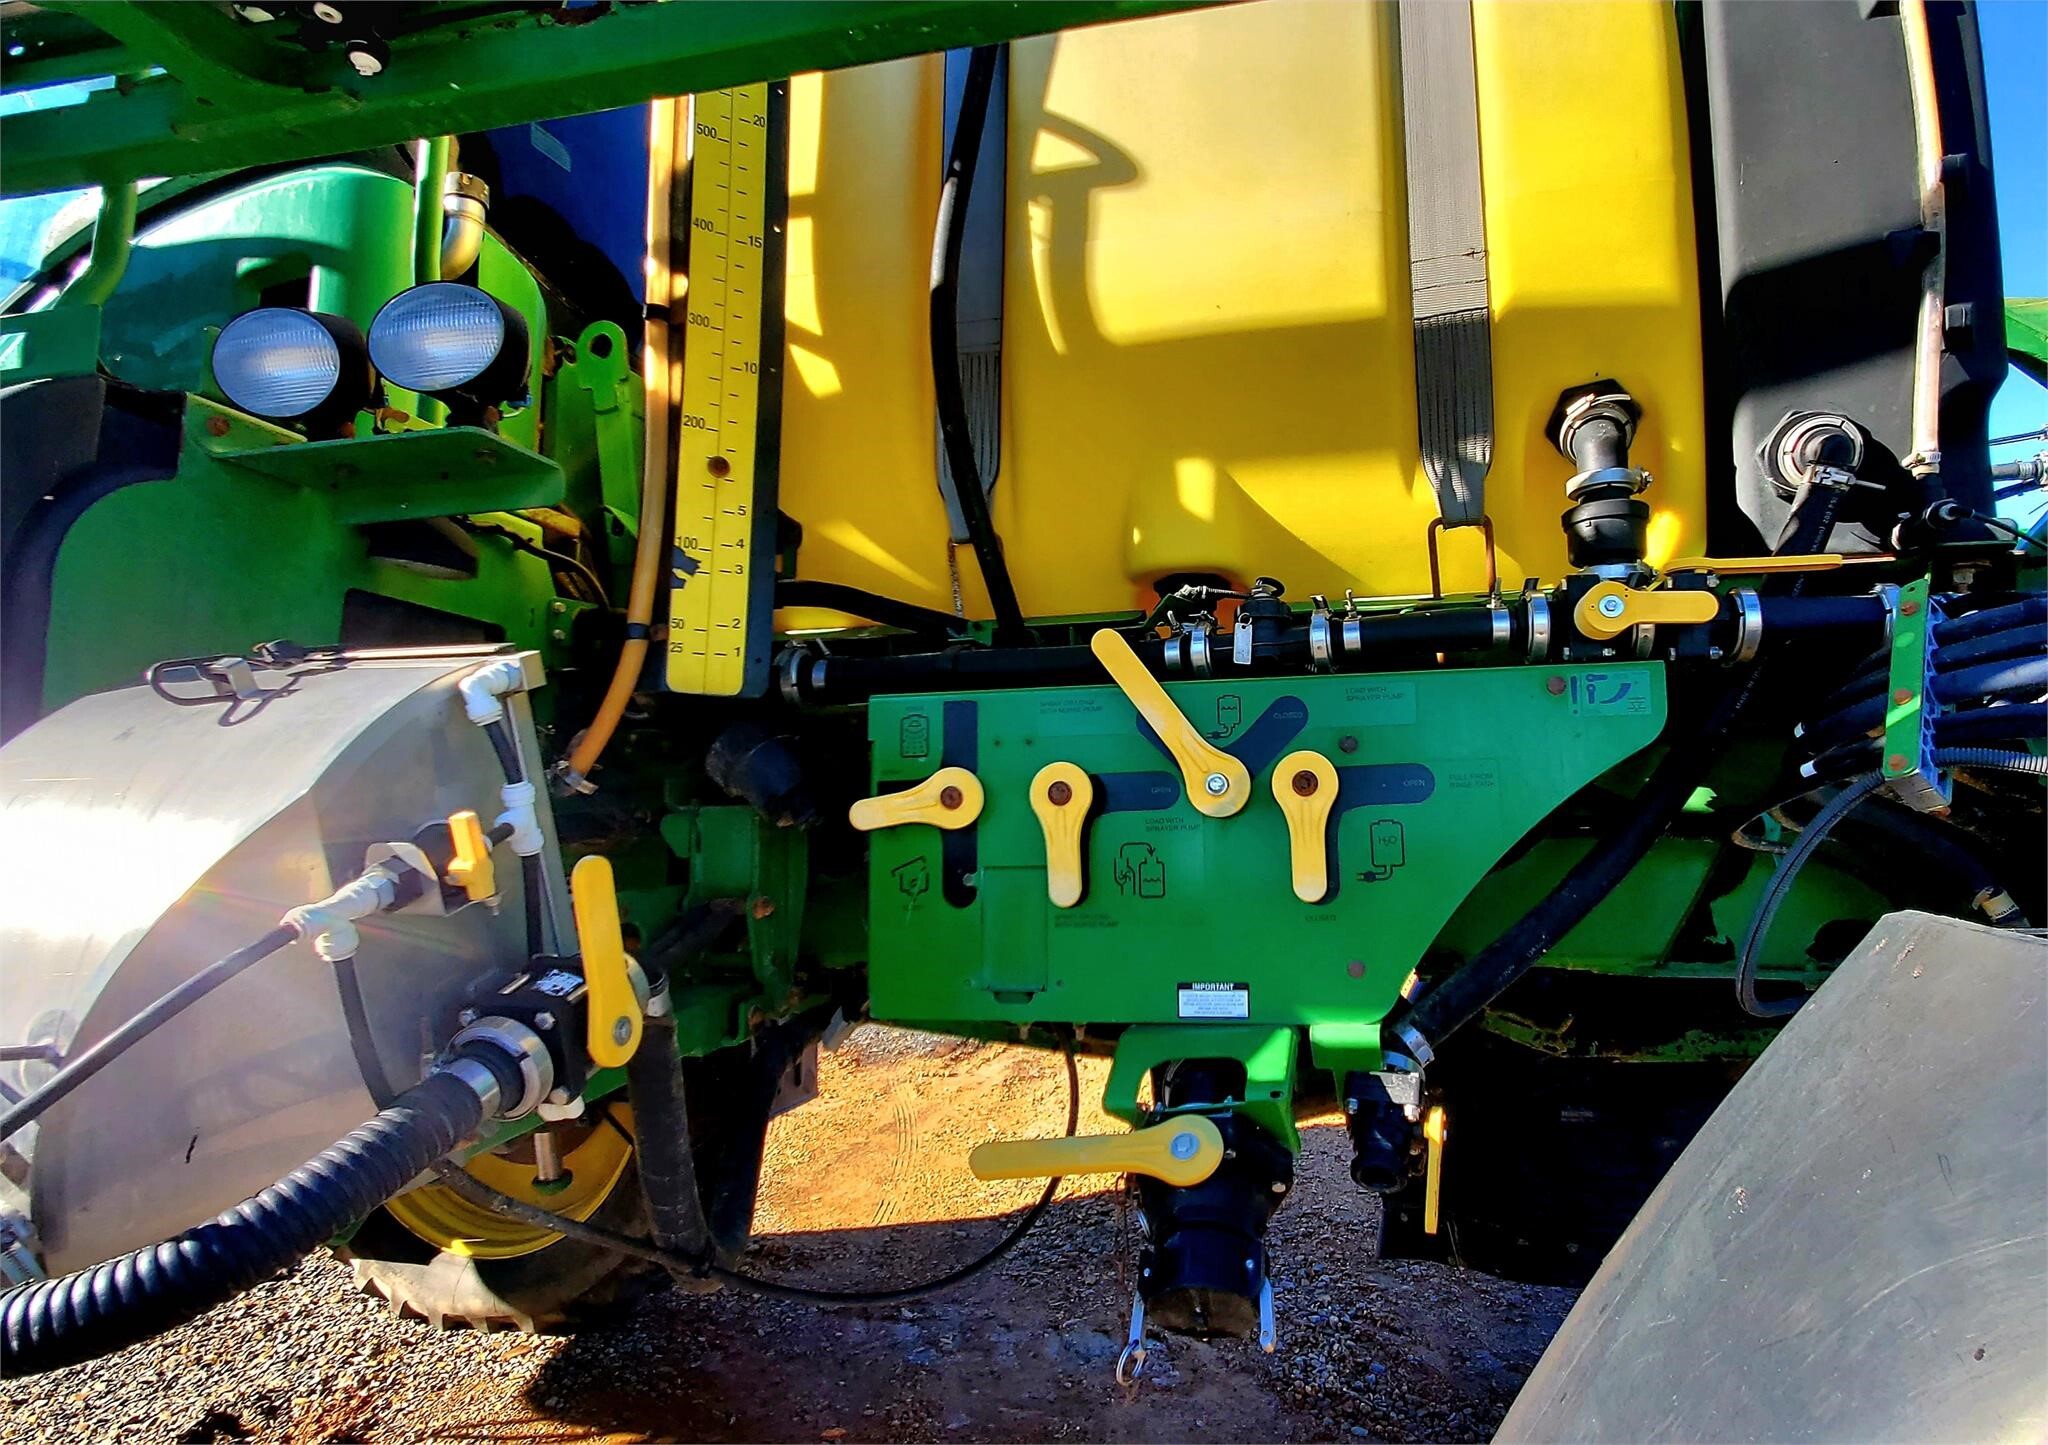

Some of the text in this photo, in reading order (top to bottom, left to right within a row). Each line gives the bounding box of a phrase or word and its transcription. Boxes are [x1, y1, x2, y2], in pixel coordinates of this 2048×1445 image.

[753, 115, 766, 128] 20
[696, 123, 717, 139] 500
[693, 217, 714, 232] 400
[748, 235, 763, 248] 15
[688, 312, 710, 328] 300
[743, 362, 758, 375] 10
[683, 415, 706, 430] 200
[737, 505, 747, 516] 5
[676, 536, 698, 550] 100
[735, 538, 745, 549] 4
[735, 565, 744, 575] 3
[671, 618, 685, 630] 50
[732, 618, 741, 629] 2
[670, 642, 684, 654] 25
[734, 647, 741, 657] 1
[1192, 981, 1235, 991] IMPORTANT
